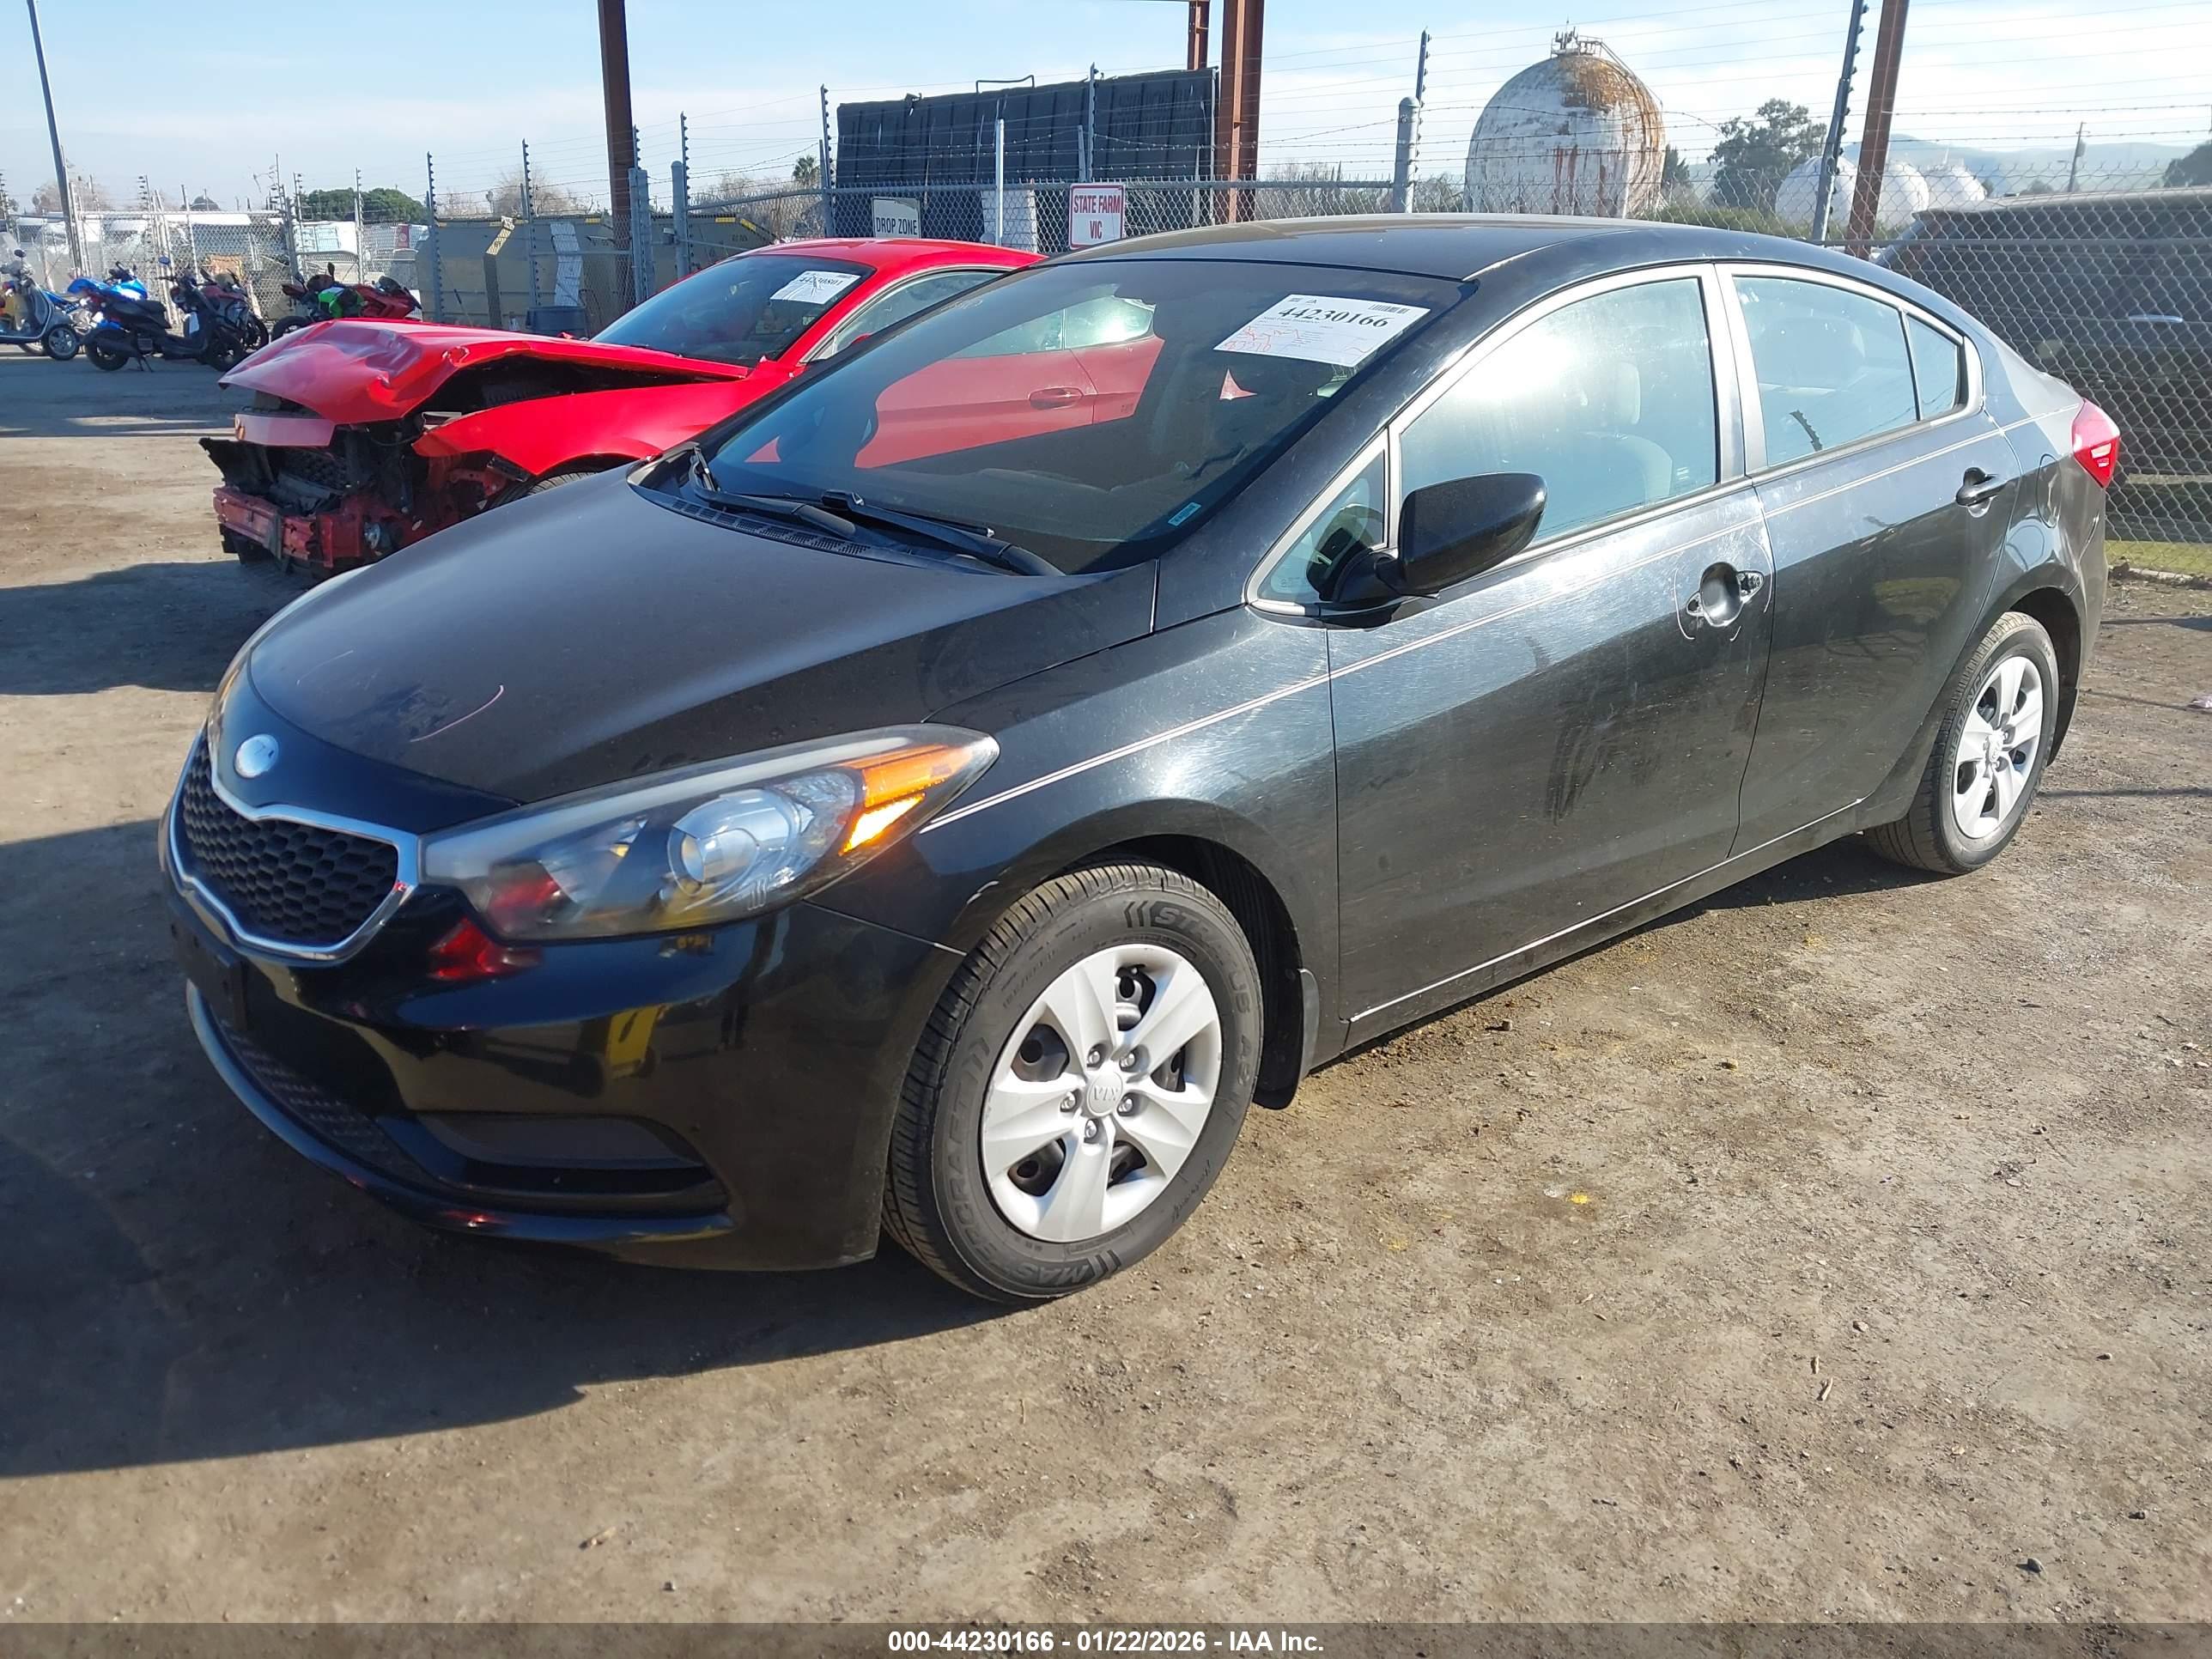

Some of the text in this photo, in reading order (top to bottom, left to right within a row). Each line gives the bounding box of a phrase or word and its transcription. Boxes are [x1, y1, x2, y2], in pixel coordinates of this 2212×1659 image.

[1073, 194, 1121, 214] STATE FARM
[876, 216, 918, 235] DROP ZONE
[1089, 220, 1103, 240] VIC
[1278, 307, 1395, 328] 44230166
